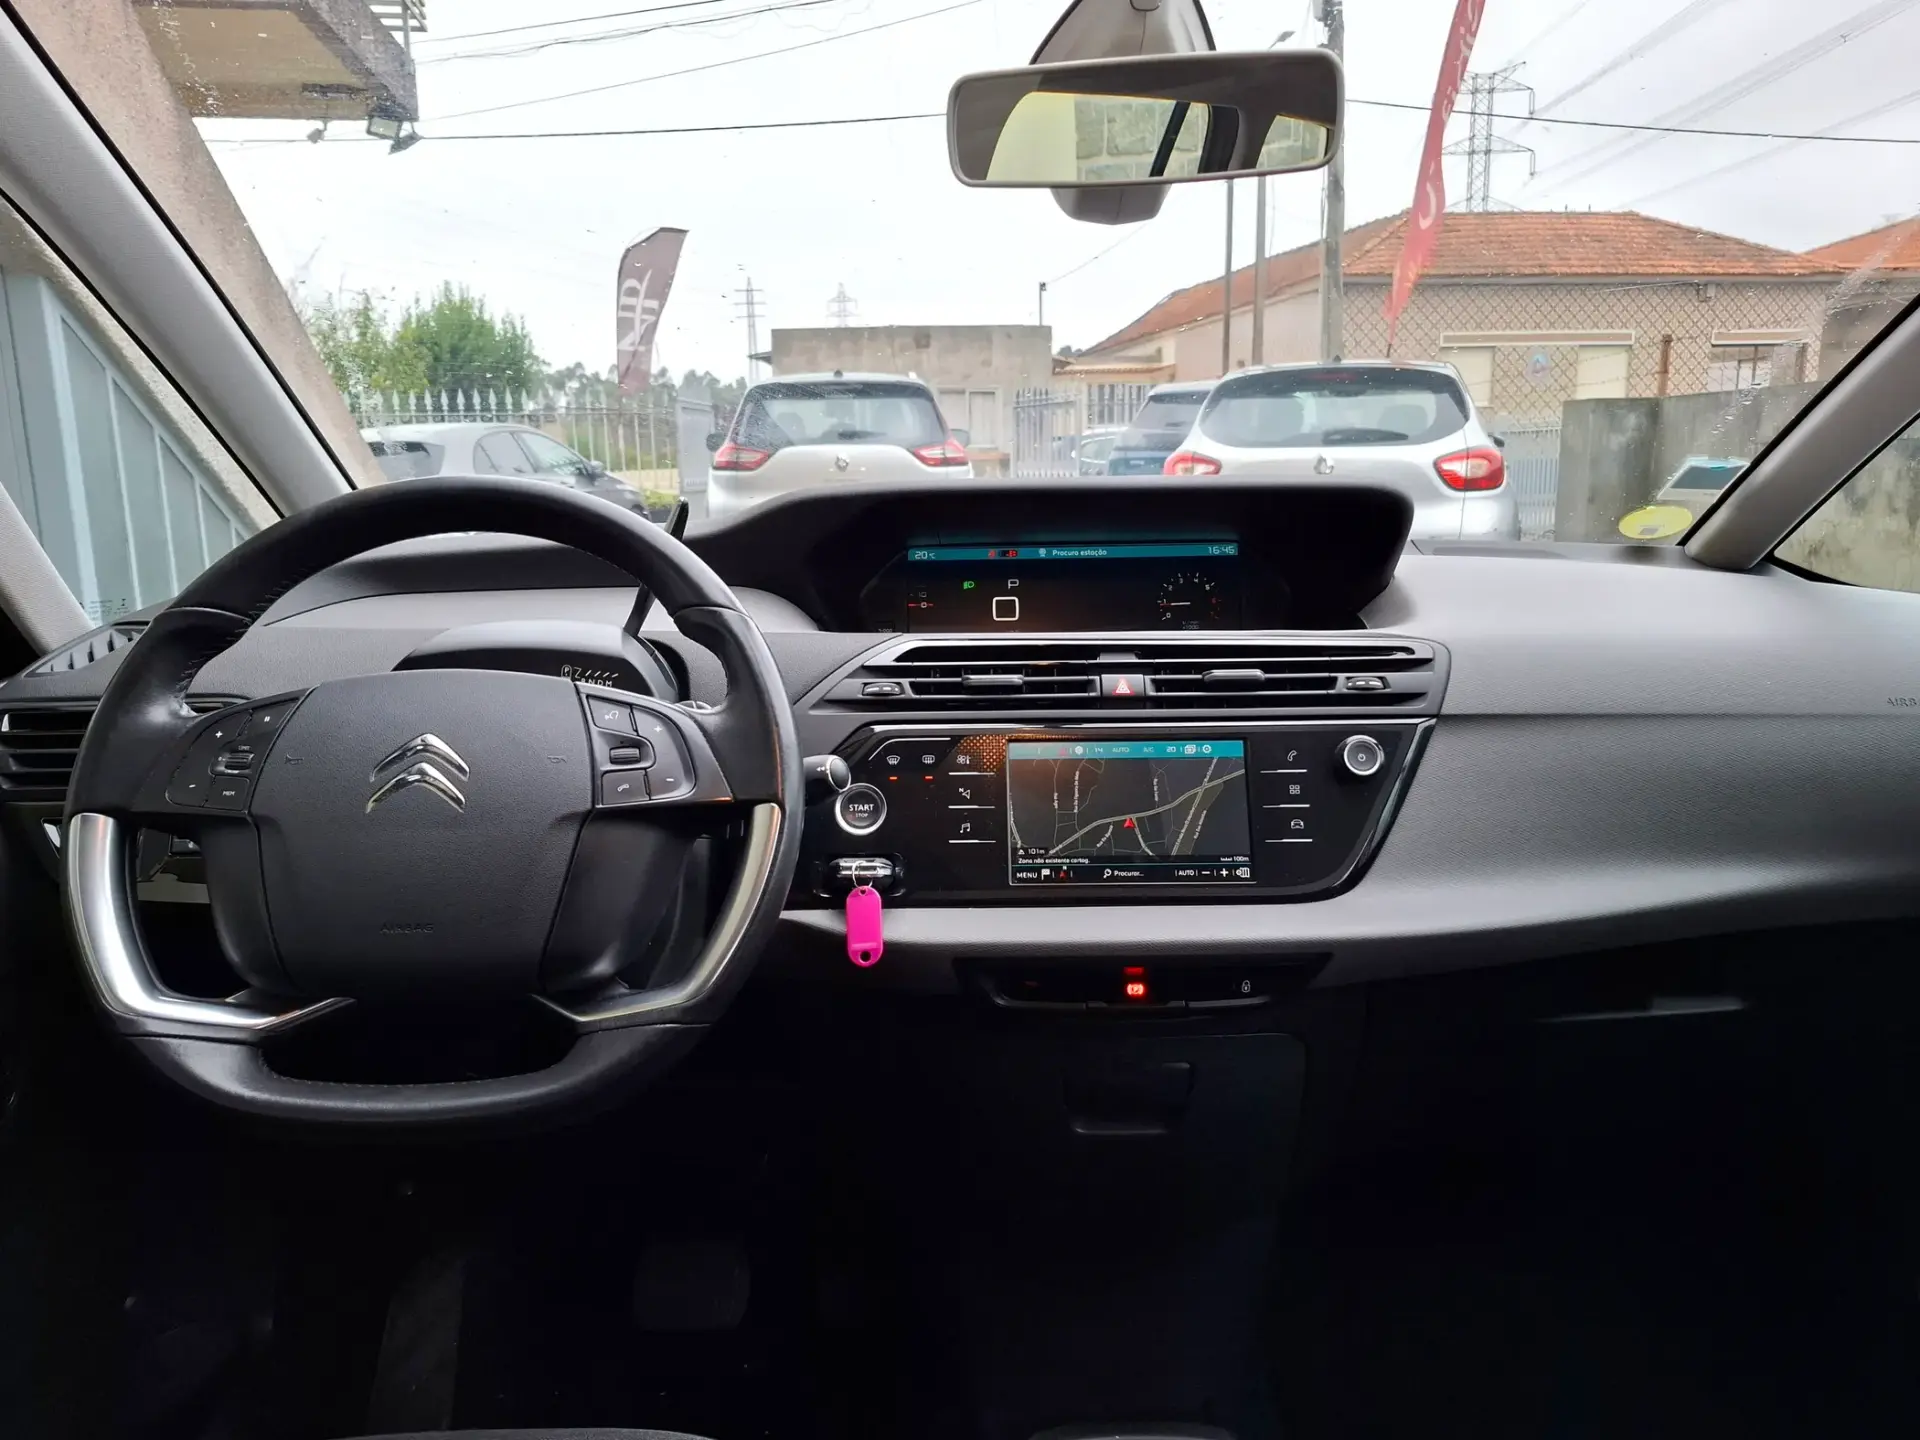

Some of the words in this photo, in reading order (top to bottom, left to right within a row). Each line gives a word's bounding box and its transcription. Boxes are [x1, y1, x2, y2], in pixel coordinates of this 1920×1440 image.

[1208, 546, 1235, 555] 16:45
[1886, 697, 1919, 707] AIRB
[848, 804, 875, 812] START
